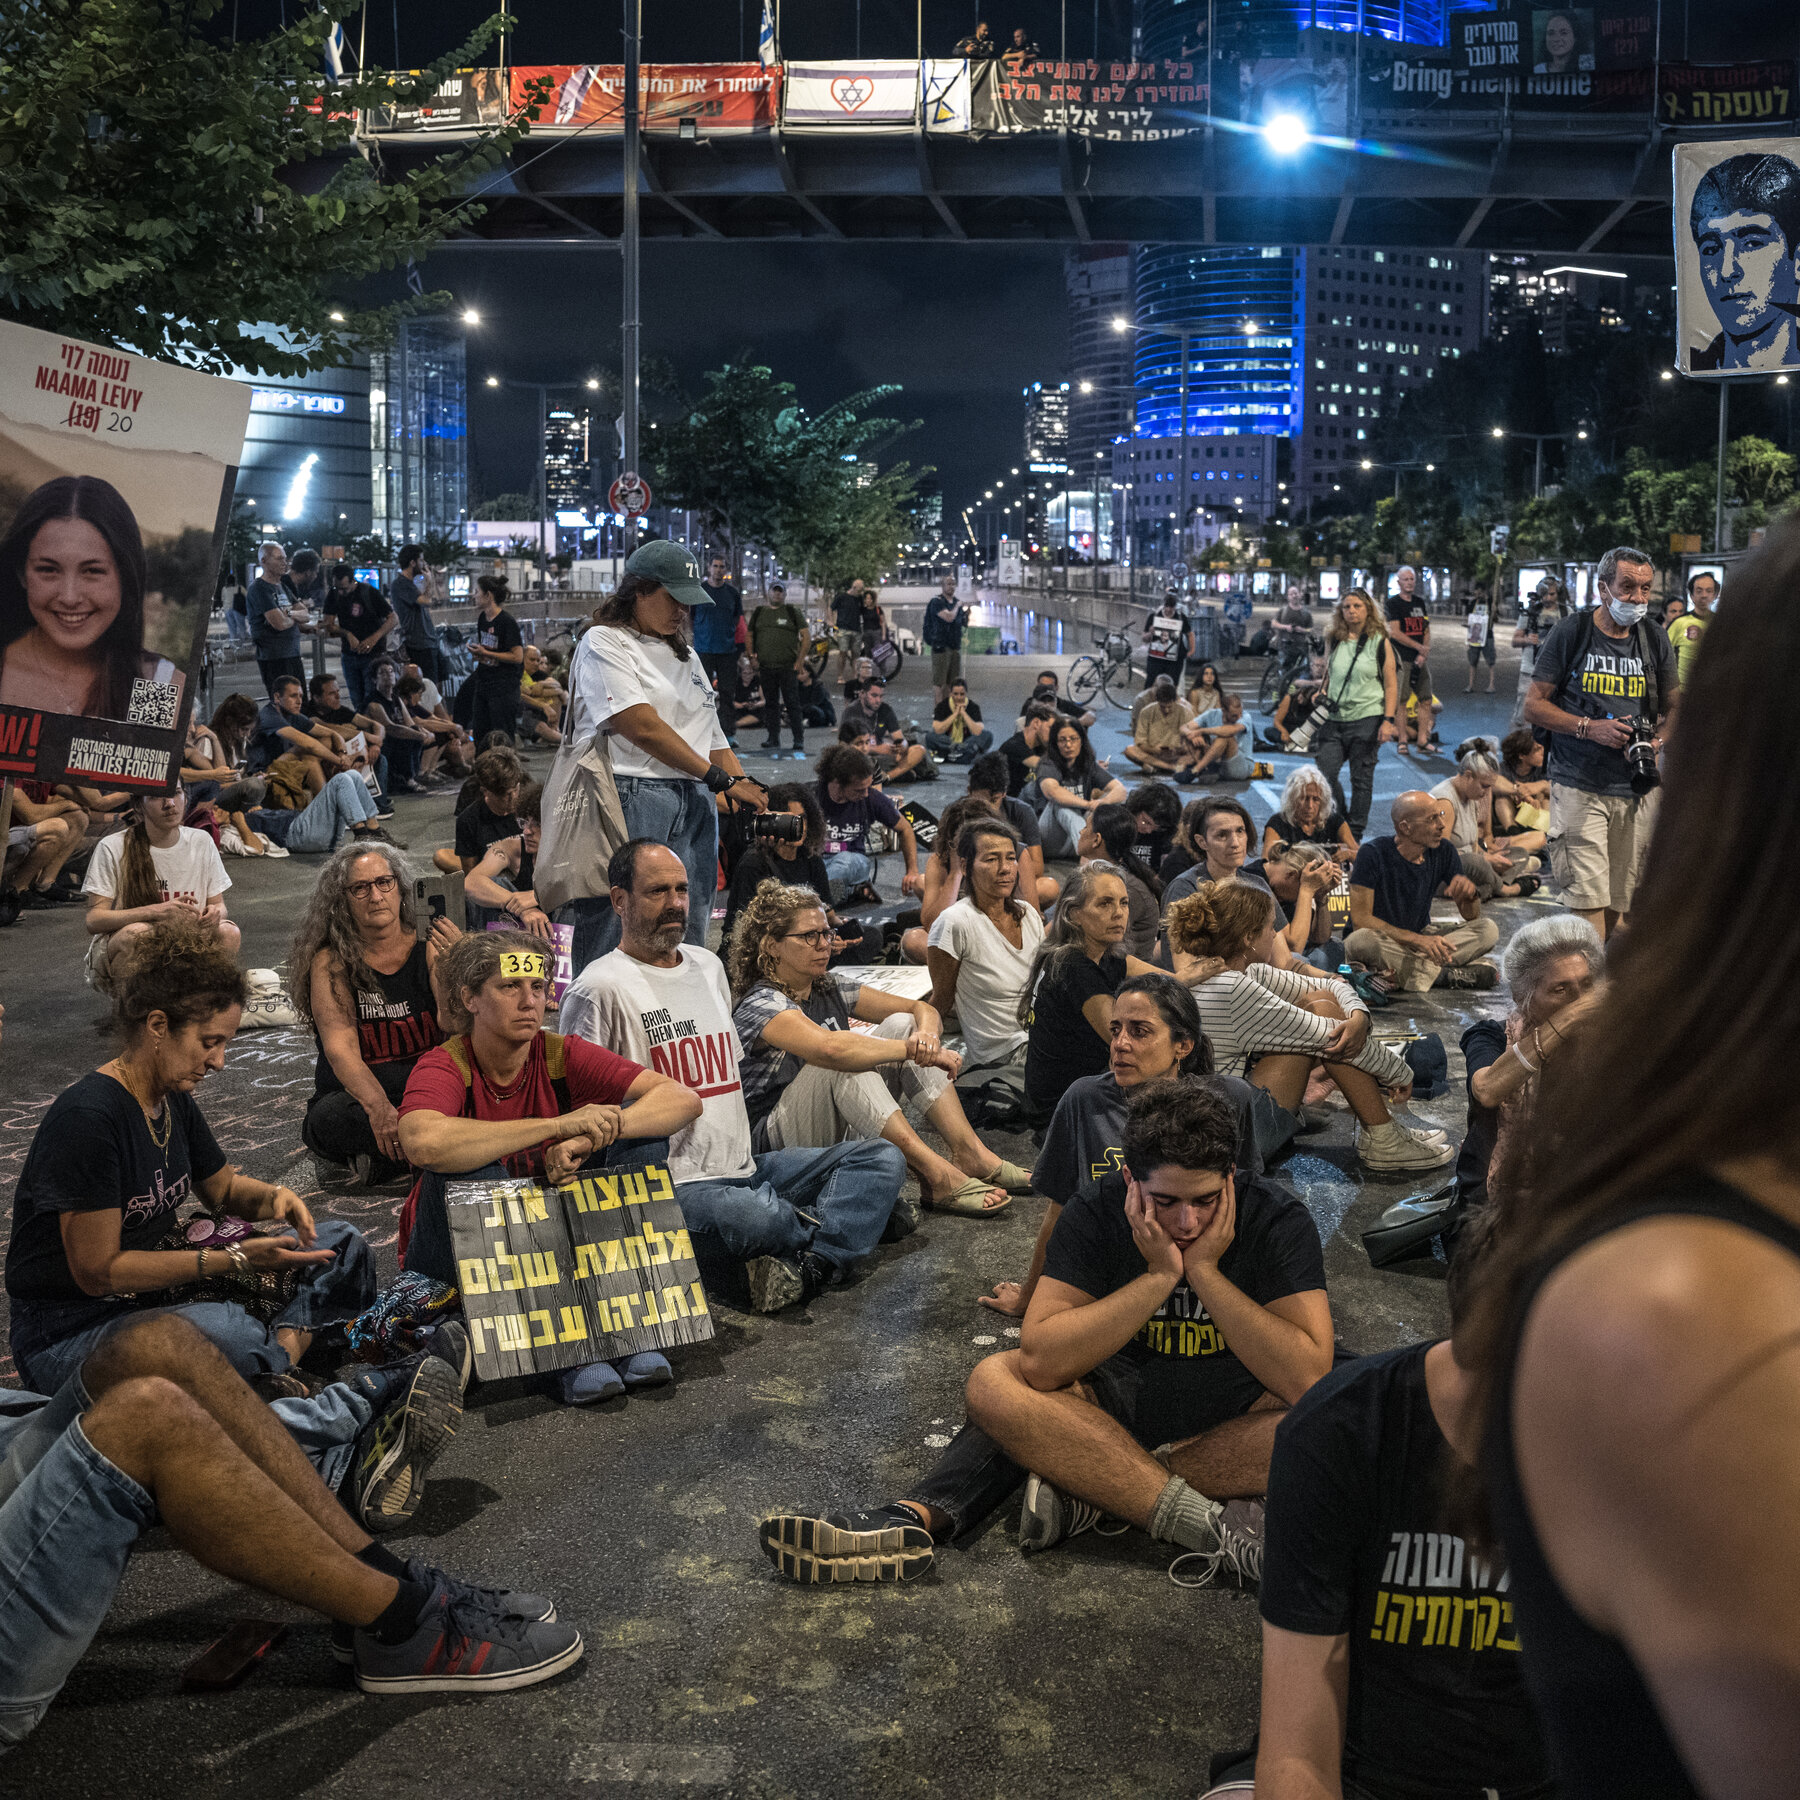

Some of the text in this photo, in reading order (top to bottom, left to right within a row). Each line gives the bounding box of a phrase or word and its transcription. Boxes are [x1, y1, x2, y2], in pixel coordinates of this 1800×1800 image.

[1464, 21, 1519, 45] מחזירים
[1464, 44, 1520, 67] את ענבר
[1110, 62, 1155, 80] העם
[1165, 58, 1194, 79] כל
[1393, 60, 1452, 99] Bring
[602, 74, 774, 94] לשחרר את החטים
[999, 79, 1040, 101] הלב
[1050, 84, 1082, 101] את
[1093, 83, 1125, 103] לנו
[1043, 105, 1153, 126] לירי אלבג
[1691, 85, 1789, 122] לעסקה
[60, 343, 130, 381] נעמה לוי
[35, 366, 143, 413] NAAMA LEVY
[106, 411, 133, 434] 20
[1584, 653, 1645, 676] אתם בבית
[1582, 672, 1646, 697] הם בעזה!
[70, 737, 171, 765] HOSTAGES AND MISSING
[67, 751, 169, 782] FAMILIES FORUM
[508, 954, 544, 973] 367
[359, 1000, 412, 1020] THEM HOME
[641, 1008, 672, 1029] BRING
[646, 1019, 698, 1046] THEM HOME
[650, 1031, 736, 1088] NOW!
[484, 1165, 675, 1228] לעצור את
[458, 1221, 696, 1296] מלחמת שלום
[470, 1282, 709, 1355] נתניהו עכשיו
[1380, 1531, 1465, 1589] שנה
[1370, 1590, 1523, 1653] פקרותיה!
